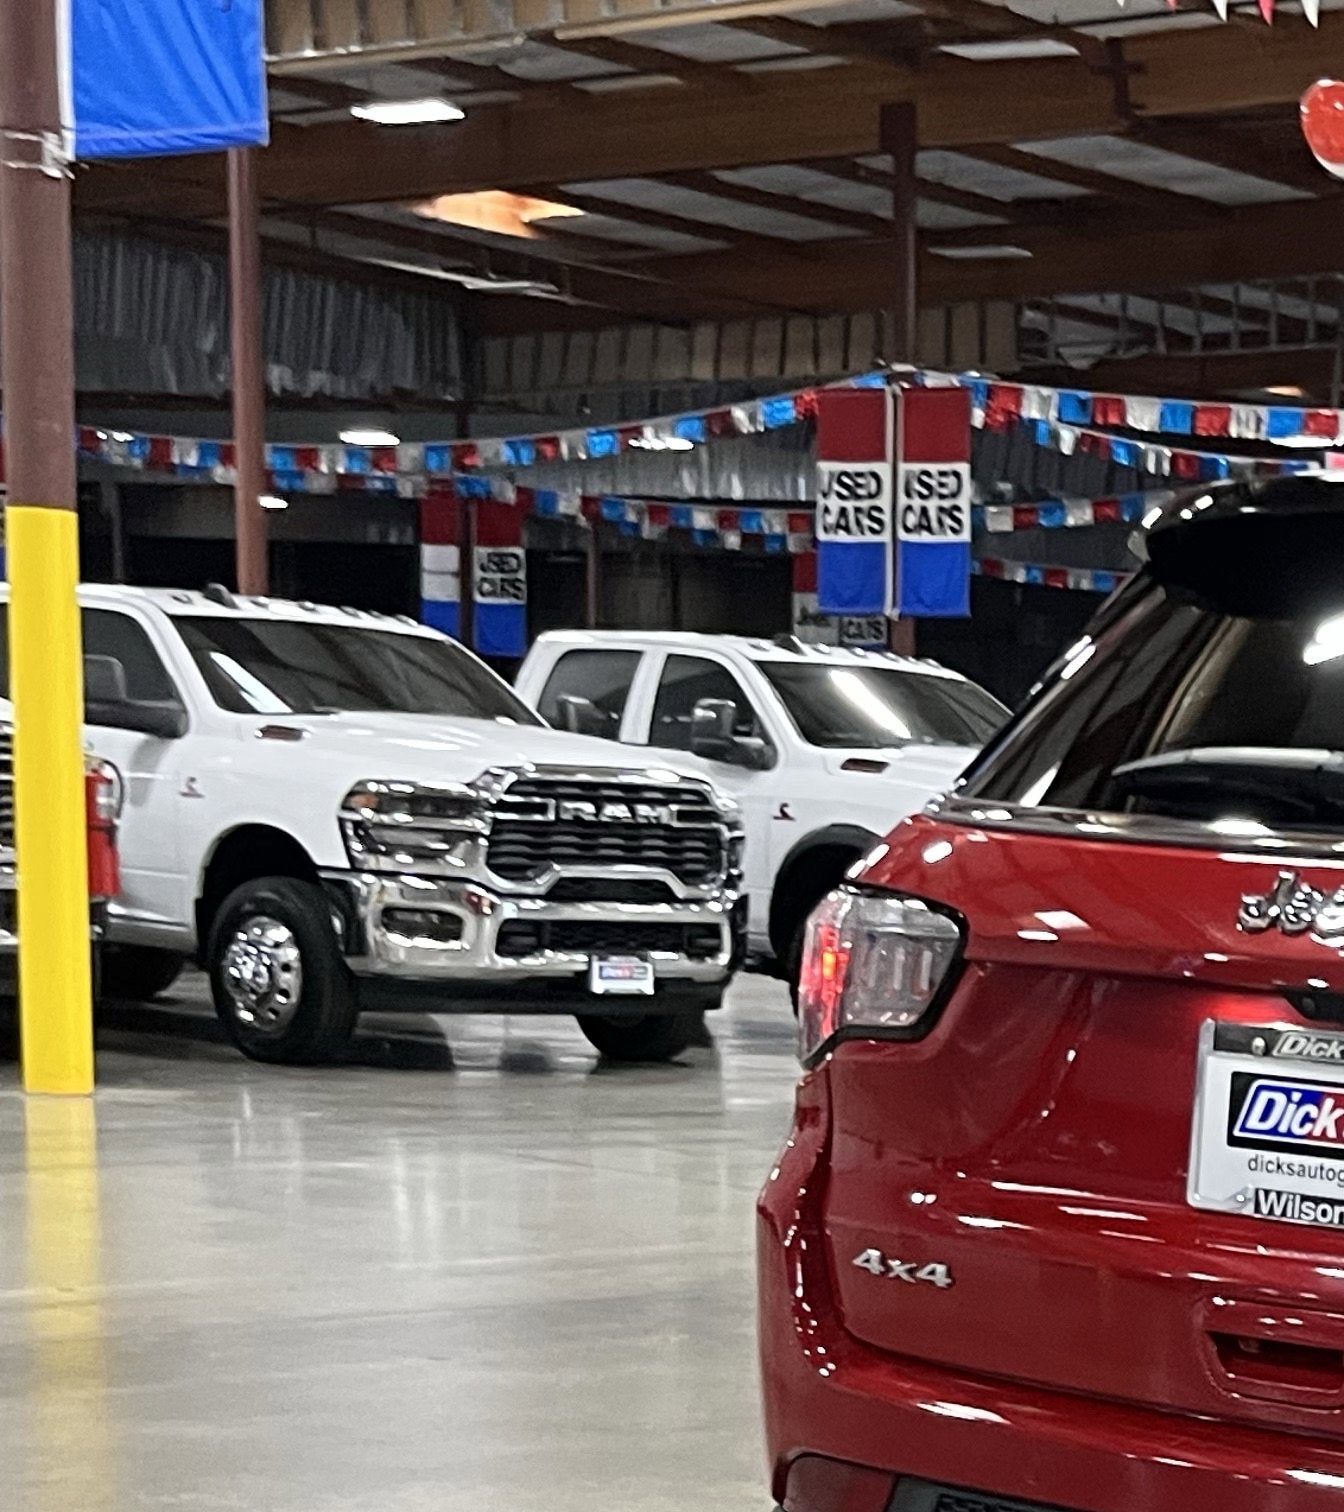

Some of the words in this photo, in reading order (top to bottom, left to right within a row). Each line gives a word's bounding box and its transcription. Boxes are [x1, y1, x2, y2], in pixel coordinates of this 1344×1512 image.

[823, 505, 885, 535] CARS
[902, 505, 965, 535] CARS
[559, 801, 671, 825] RAM
[852, 1247, 952, 1289] 4x4
